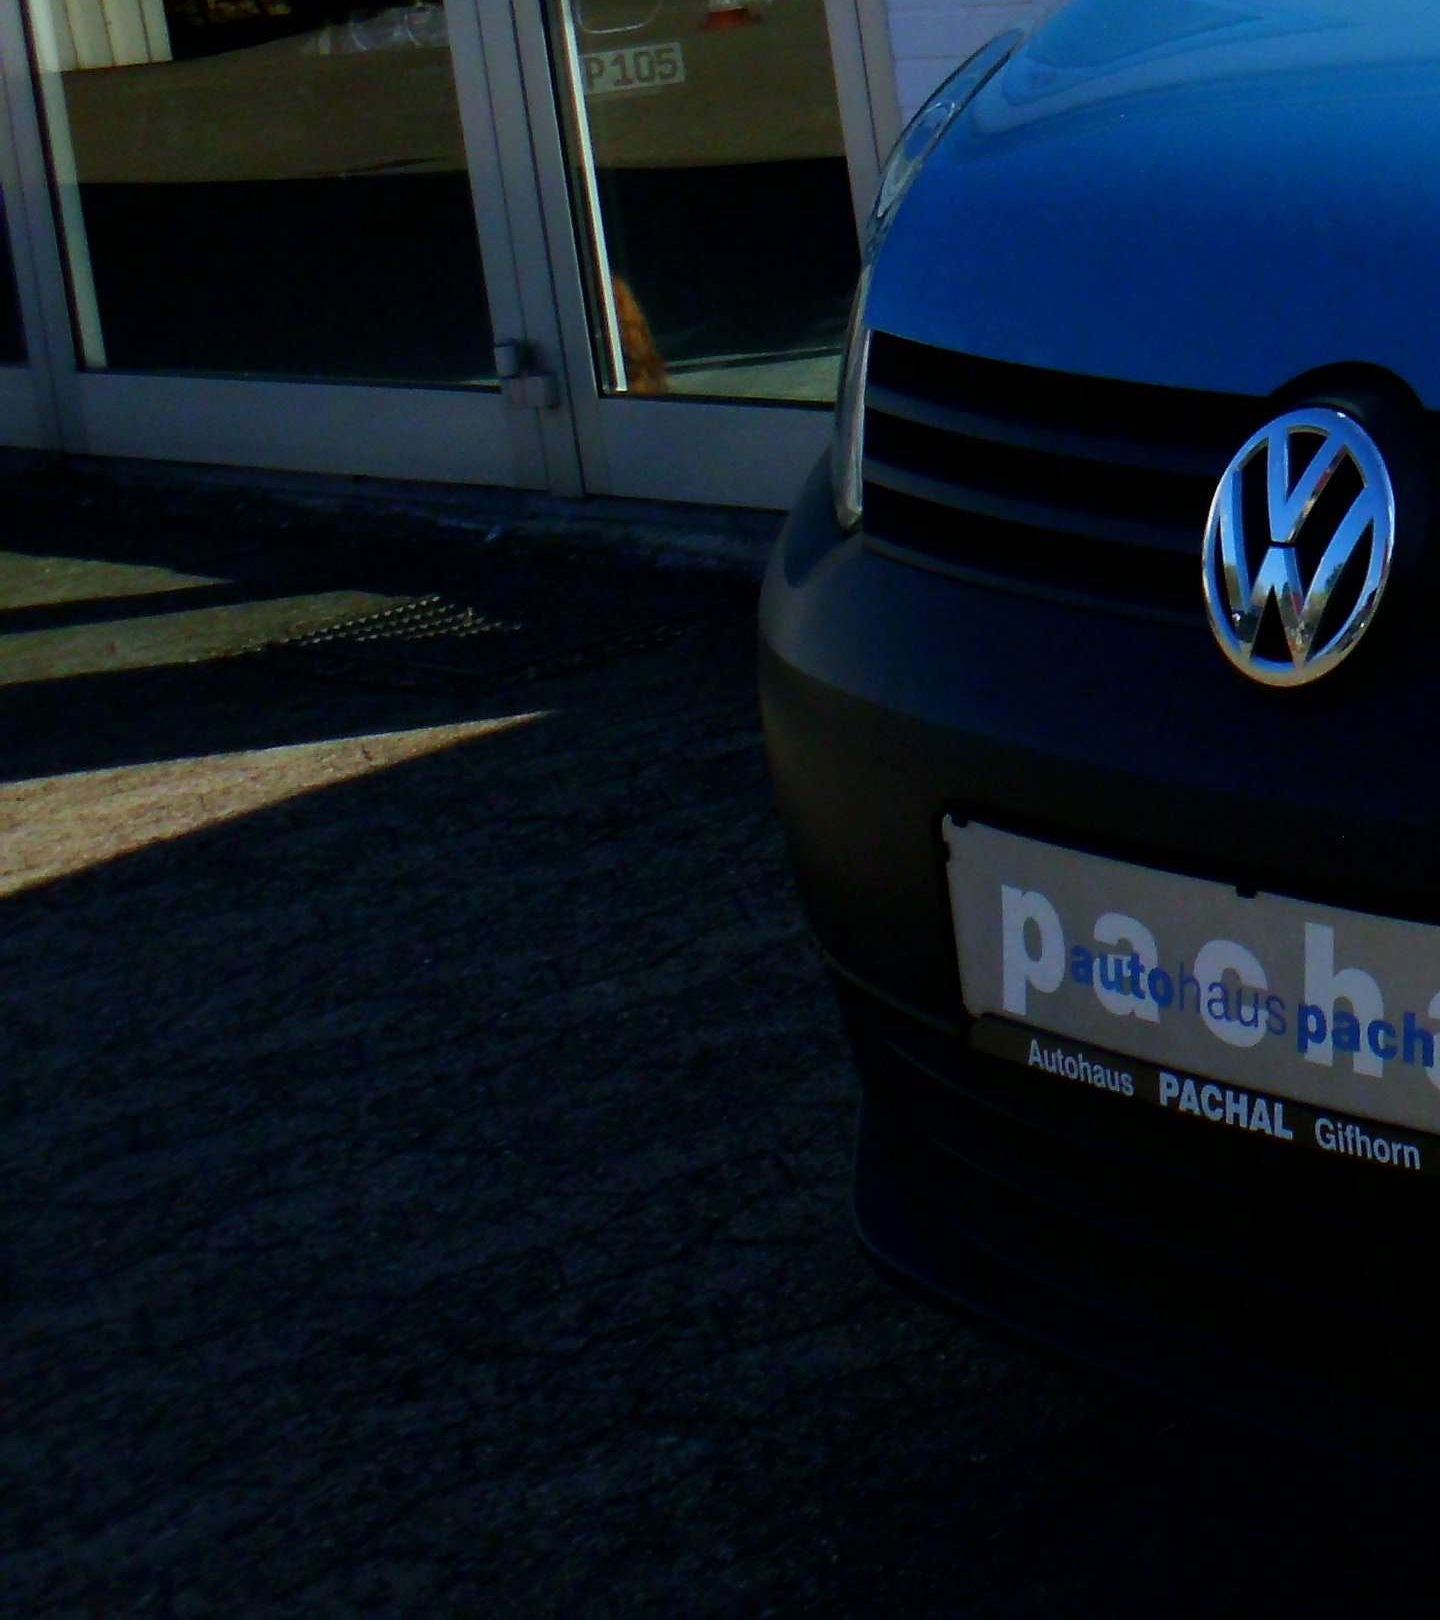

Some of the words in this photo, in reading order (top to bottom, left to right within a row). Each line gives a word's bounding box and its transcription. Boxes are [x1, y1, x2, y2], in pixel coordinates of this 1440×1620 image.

[1028, 1037, 1135, 1097] Autohaus
[1159, 1072, 1294, 1141] PACHAL
[1314, 1118, 1421, 1170] Gifhorn
